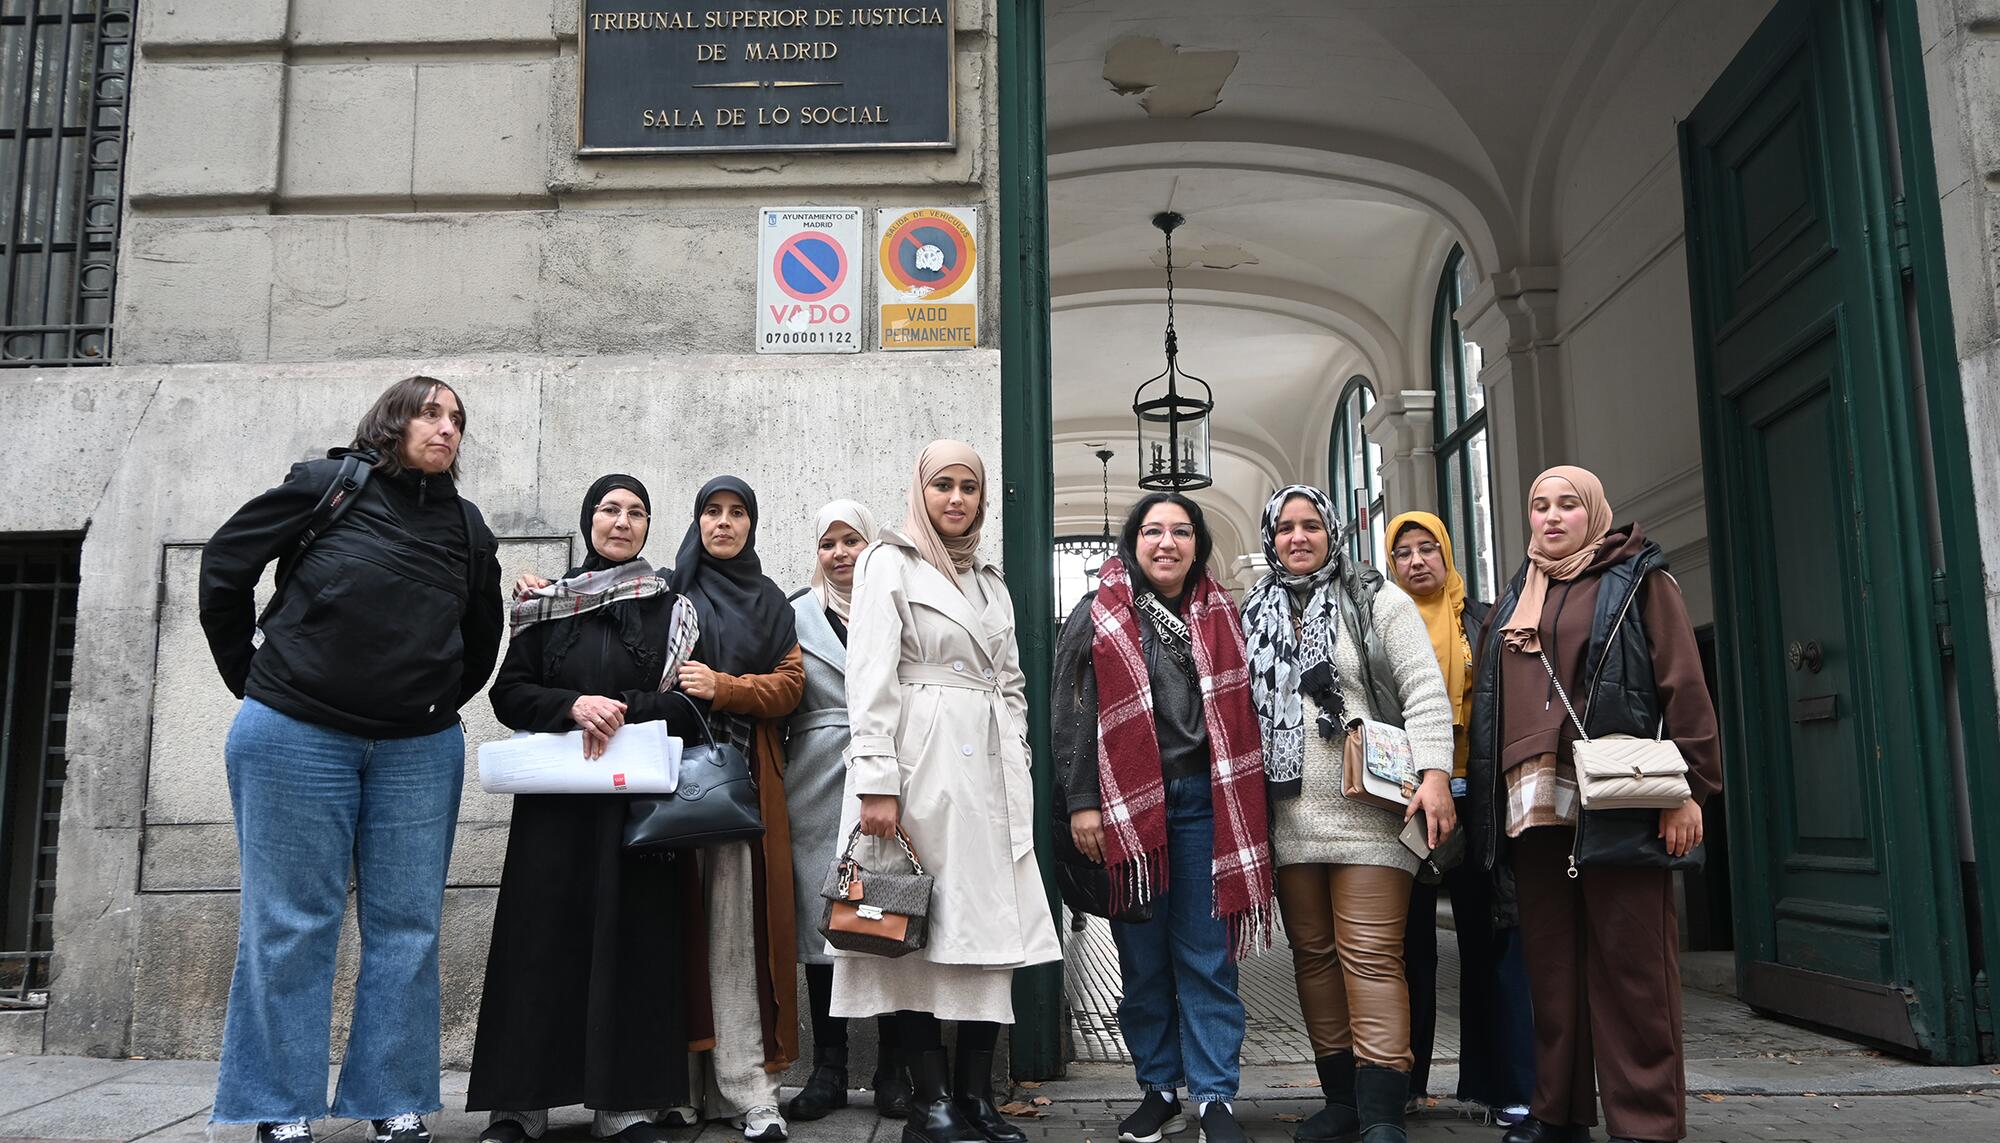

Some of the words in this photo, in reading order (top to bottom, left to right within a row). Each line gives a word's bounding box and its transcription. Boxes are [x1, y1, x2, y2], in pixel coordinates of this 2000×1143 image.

[590, 11, 700, 31] TRIBUNAL
[704, 9, 809, 28] SUPERIOR
[814, 8, 844, 27] DE
[848, 7, 944, 26] JUSTICIA
[697, 43, 727, 62] DE
[744, 41, 839, 62] MADRID
[642, 109, 705, 128] SALA
[716, 108, 746, 127] DE
[758, 105, 790, 125] LO
[800, 105, 889, 126] SOCIAL
[886, 216, 910, 239] SALIDA
[912, 210, 924, 218] DE
[906, 307, 947, 322] VADO
[766, 332, 852, 344] 0700001122
[885, 327, 972, 342] PERMANENTE
